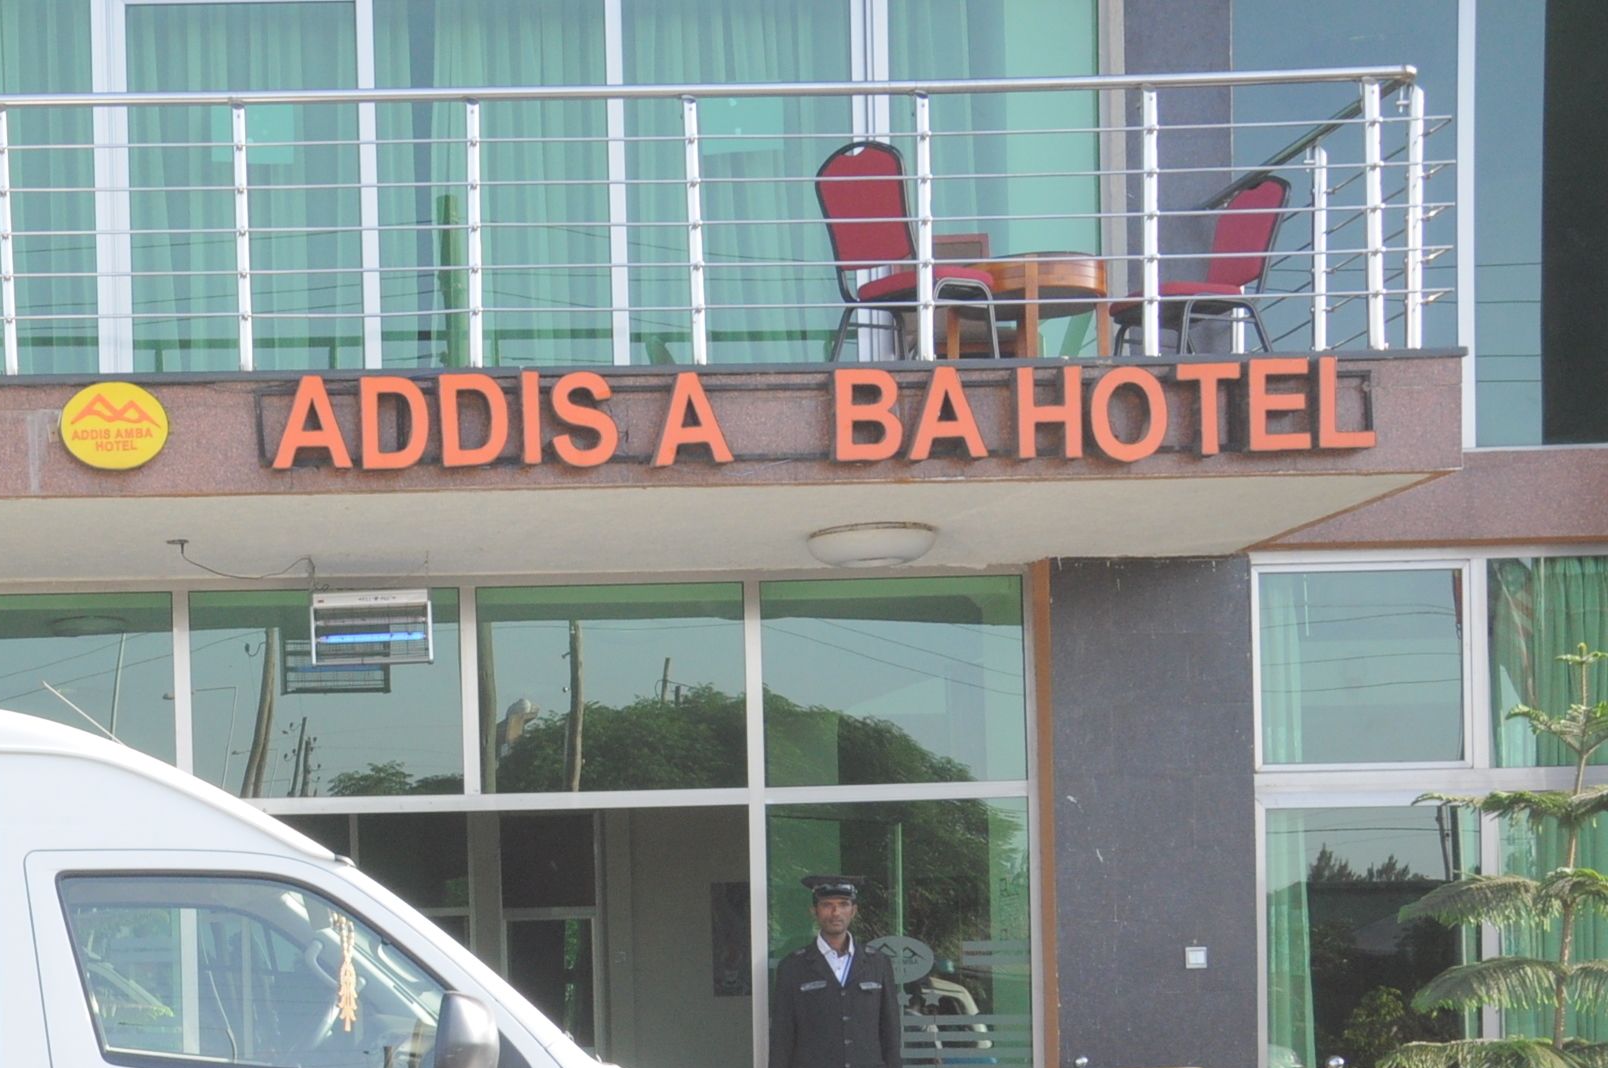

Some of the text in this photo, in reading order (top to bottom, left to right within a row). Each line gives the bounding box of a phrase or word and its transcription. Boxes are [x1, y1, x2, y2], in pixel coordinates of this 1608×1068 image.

[272, 370, 619, 469] ADDIS
[1016, 356, 1377, 463] HOTEL
[72, 427, 153, 441] ADDIS AMBA
[96, 440, 138, 452] HOTEL
